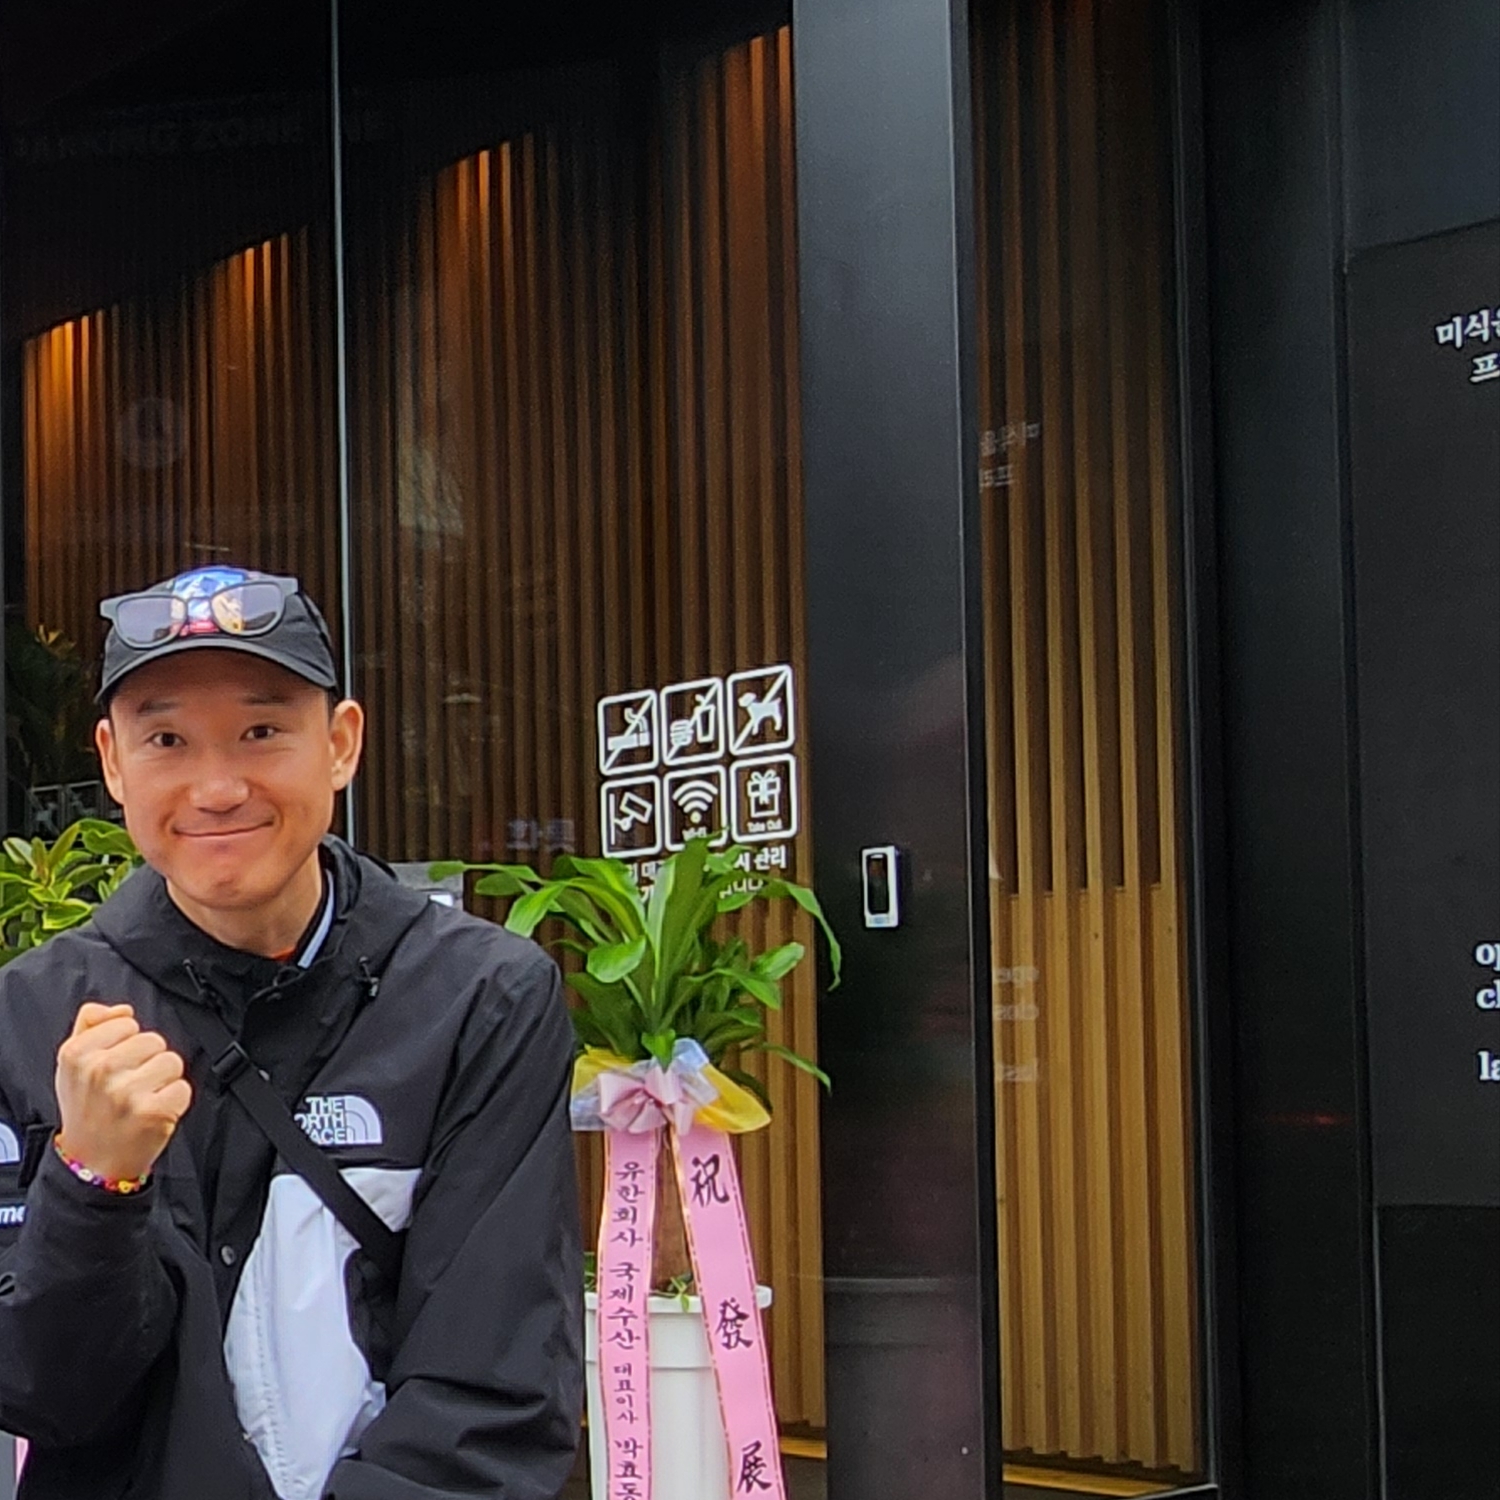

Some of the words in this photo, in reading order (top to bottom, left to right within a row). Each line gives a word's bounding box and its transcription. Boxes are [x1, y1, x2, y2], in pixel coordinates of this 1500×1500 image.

[1435, 308, 1500, 349] 미식
[294, 1113, 345, 1132] ORTH
[304, 1095, 344, 1115] THE
[307, 1128, 347, 1145] ACE
[610, 1161, 645, 1248] 유한회사
[607, 1261, 641, 1350] 국제수산
[613, 1362, 638, 1424] 대표이사
